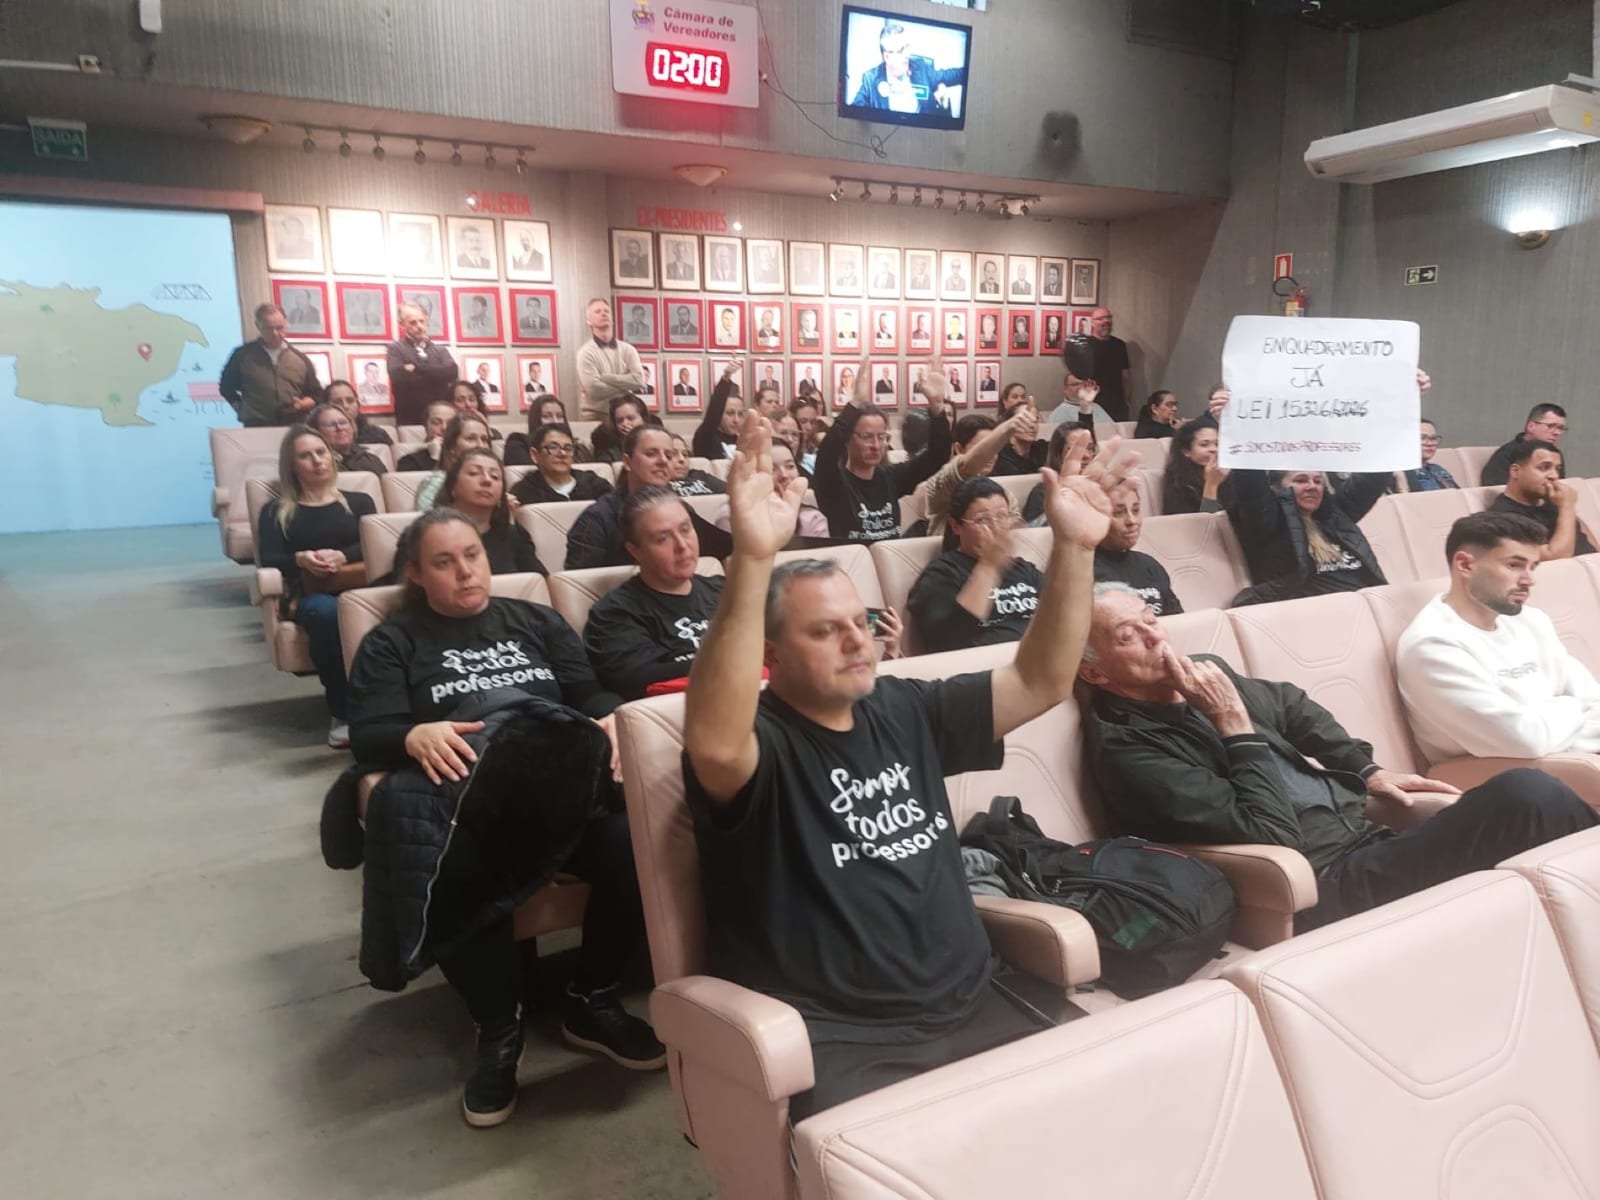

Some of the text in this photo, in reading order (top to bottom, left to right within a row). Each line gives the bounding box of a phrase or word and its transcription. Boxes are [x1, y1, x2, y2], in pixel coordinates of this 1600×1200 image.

[718, 14, 734, 28] de
[663, 22, 737, 43] Vereadores
[1263, 337, 1394, 357] ENQUADRAMENTO
[1290, 364, 1325, 388] JÁ
[430, 667, 556, 704] professores
[844, 798, 926, 840] todos
